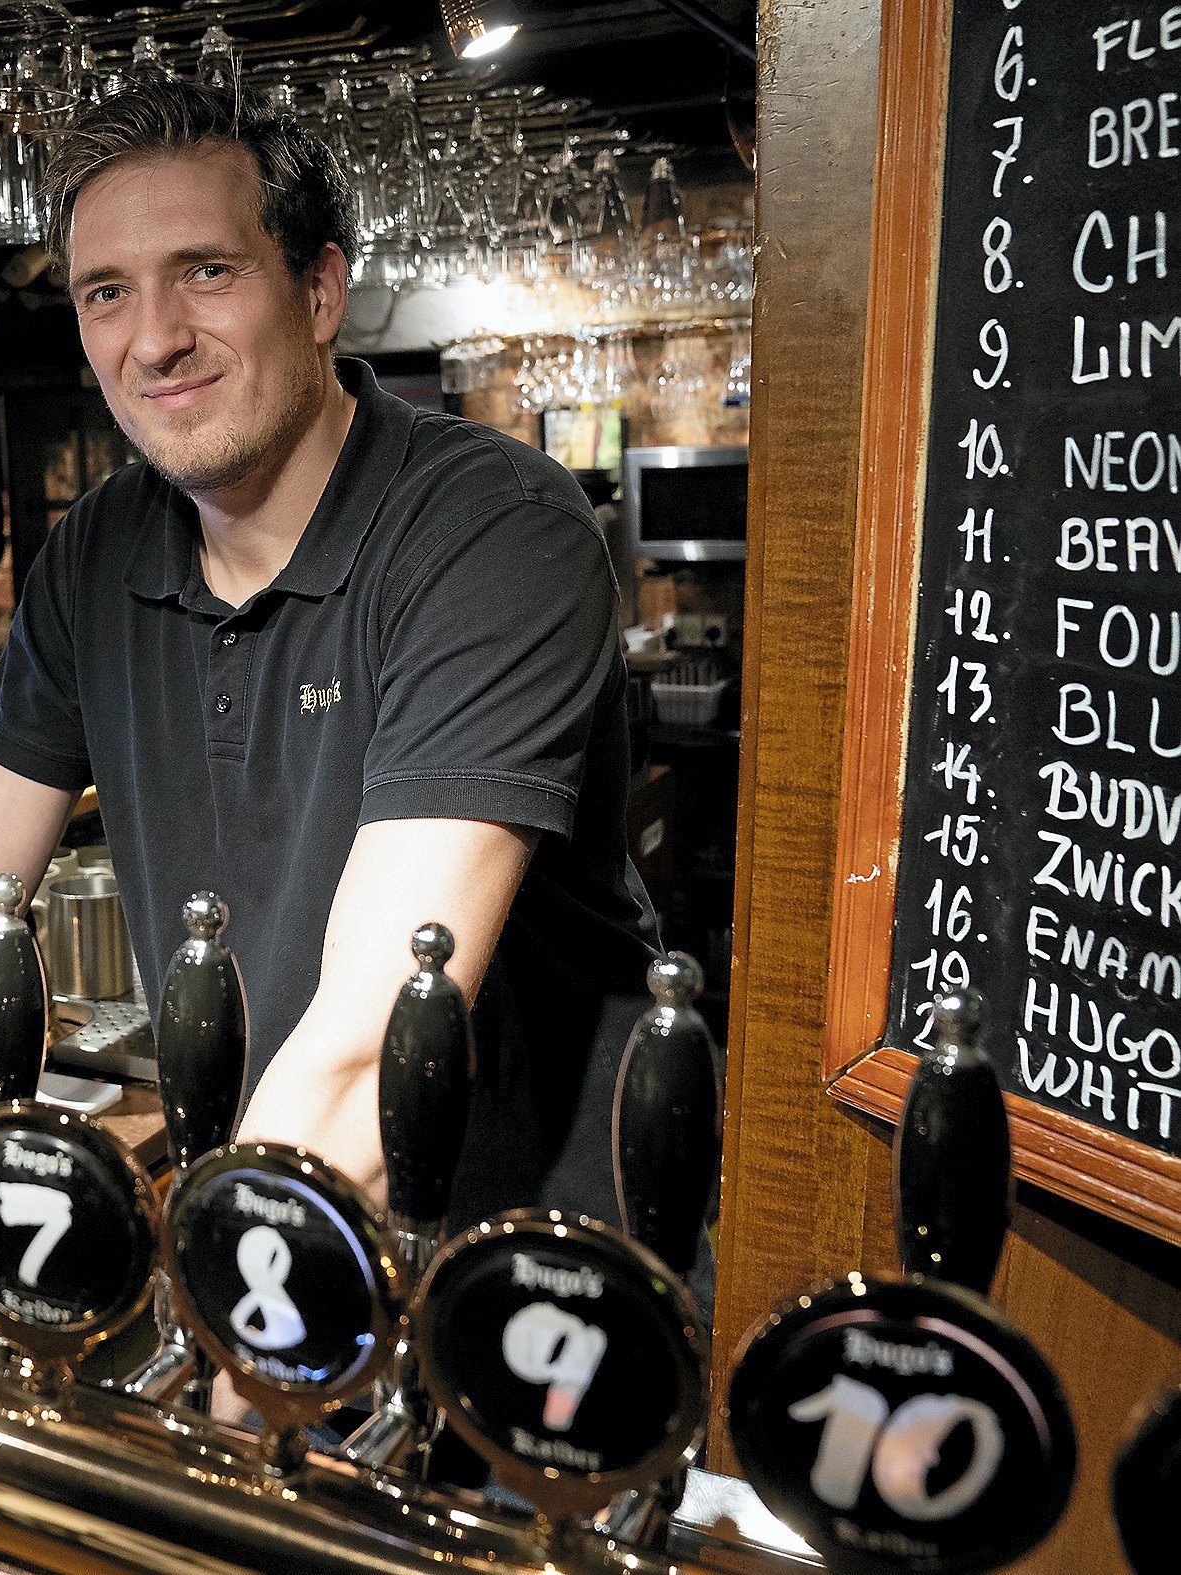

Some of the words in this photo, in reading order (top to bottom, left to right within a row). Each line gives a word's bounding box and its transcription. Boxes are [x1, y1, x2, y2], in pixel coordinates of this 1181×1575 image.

[994, 24, 1038, 102] 6.
[992, 116, 1034, 198] 7.
[1088, 92, 1181, 169] BRE
[982, 216, 1025, 294] 8.
[1072, 209, 1167, 294] CH
[972, 318, 1012, 390] 9.
[957, 418, 1010, 480] 10.
[957, 507, 1010, 564] 11.
[945, 588, 1011, 643] 12.
[1056, 597, 1181, 676] FOU
[937, 656, 997, 724] 13.
[932, 742, 996, 805] 14.
[924, 814, 990, 867] 15.
[924, 878, 988, 942] 16.
[1027, 906, 1181, 1000] ENAM
[1024, 978, 1181, 1079] HUGO
[228, 1224, 308, 1351] 8
[501, 1300, 609, 1433] 9
[786, 1371, 1007, 1523] 10
